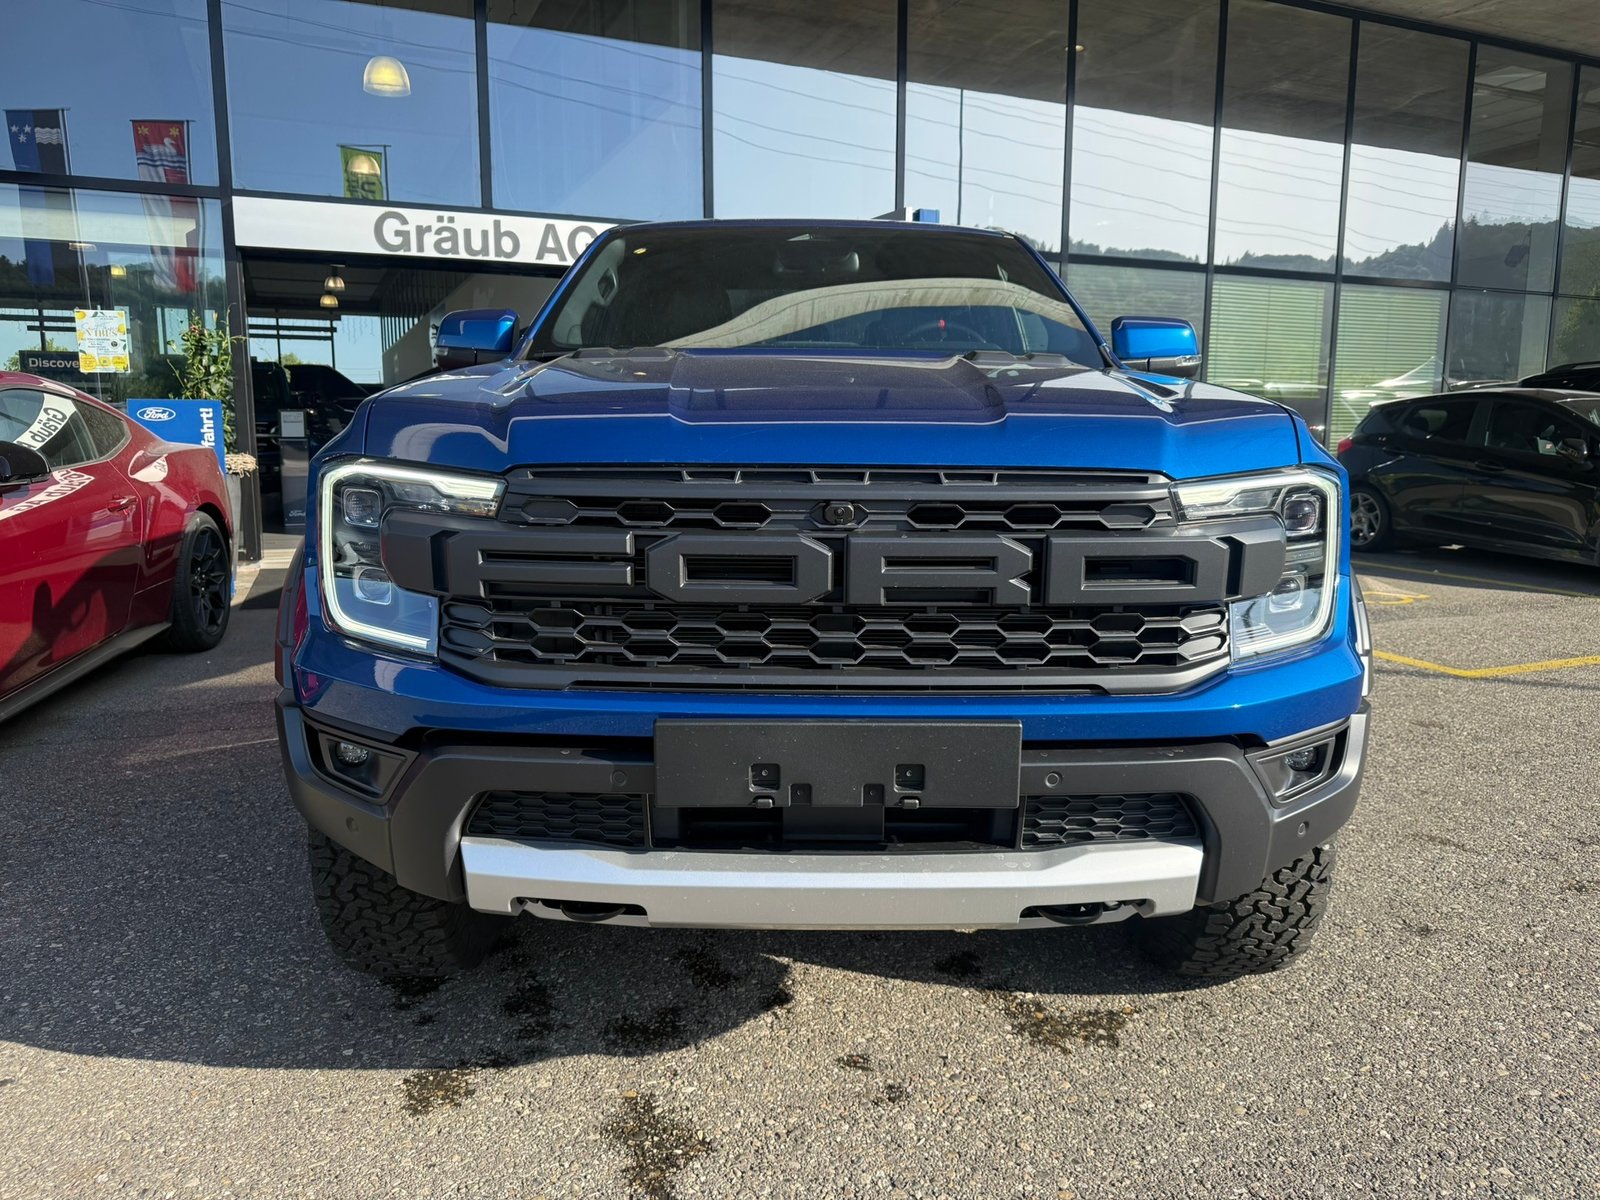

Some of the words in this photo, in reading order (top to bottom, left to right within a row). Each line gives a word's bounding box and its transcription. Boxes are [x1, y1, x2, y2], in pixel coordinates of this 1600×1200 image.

[373, 210, 520, 260] Gräub
[29, 357, 79, 368] Discove
[143, 407, 170, 421] Ford
